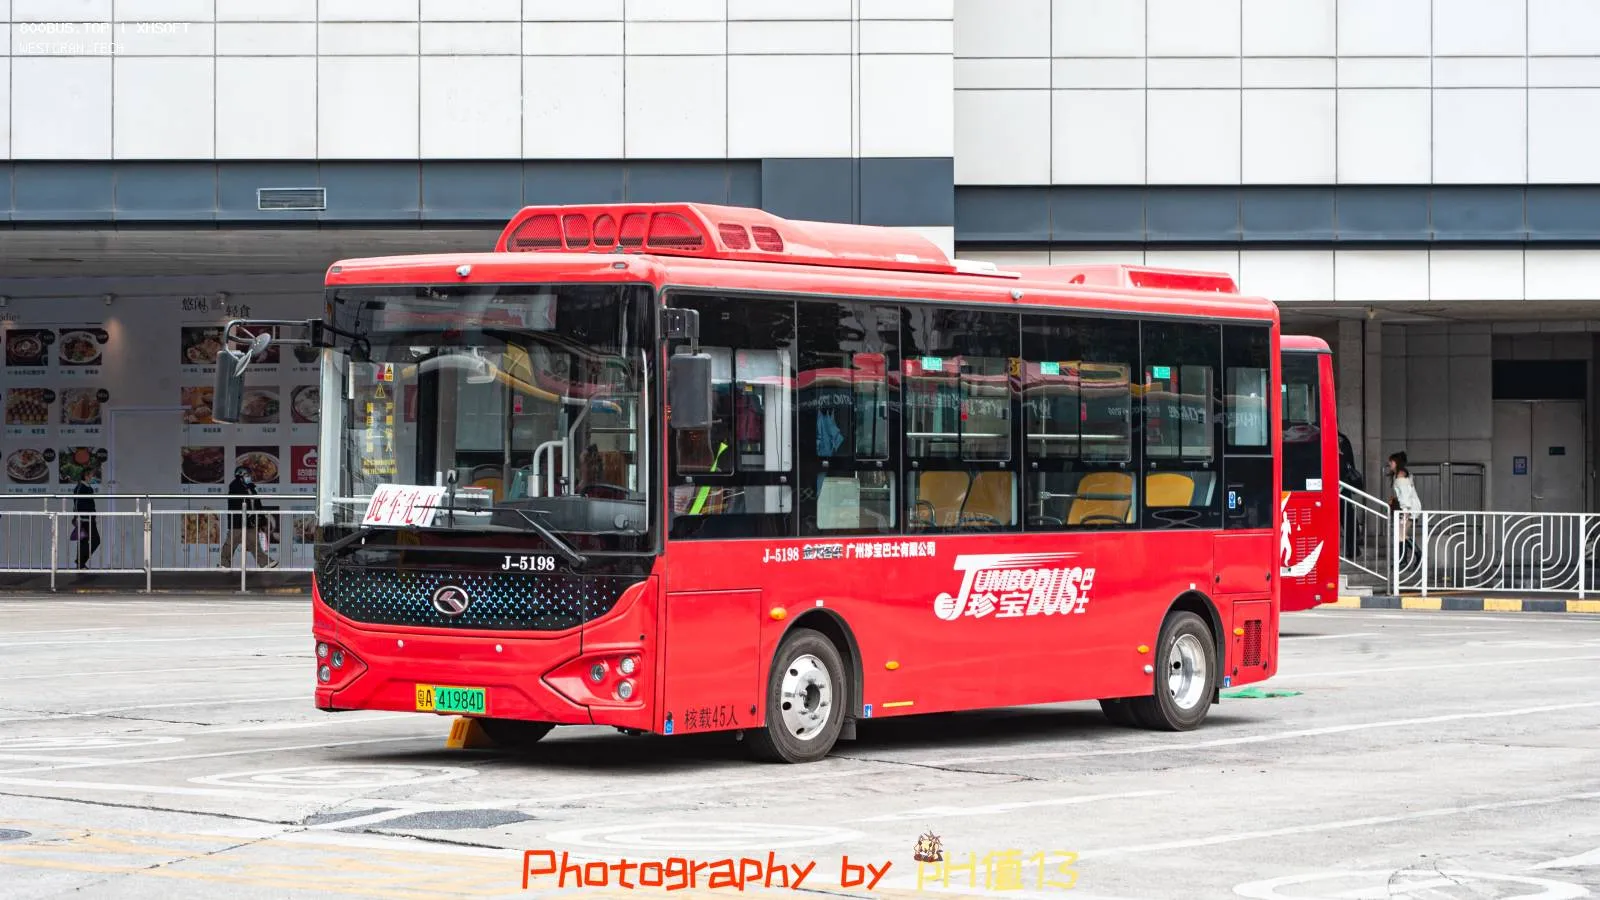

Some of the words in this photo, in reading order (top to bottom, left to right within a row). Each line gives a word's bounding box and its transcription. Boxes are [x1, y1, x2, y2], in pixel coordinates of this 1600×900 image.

[762, 547, 800, 563] J-5198
[846, 541, 937, 559] 广州珍宝巴士有限公司
[502, 555, 556, 572] J-5198
[438, 689, 485, 712] 41984D
[684, 704, 739, 730] 核载45人
